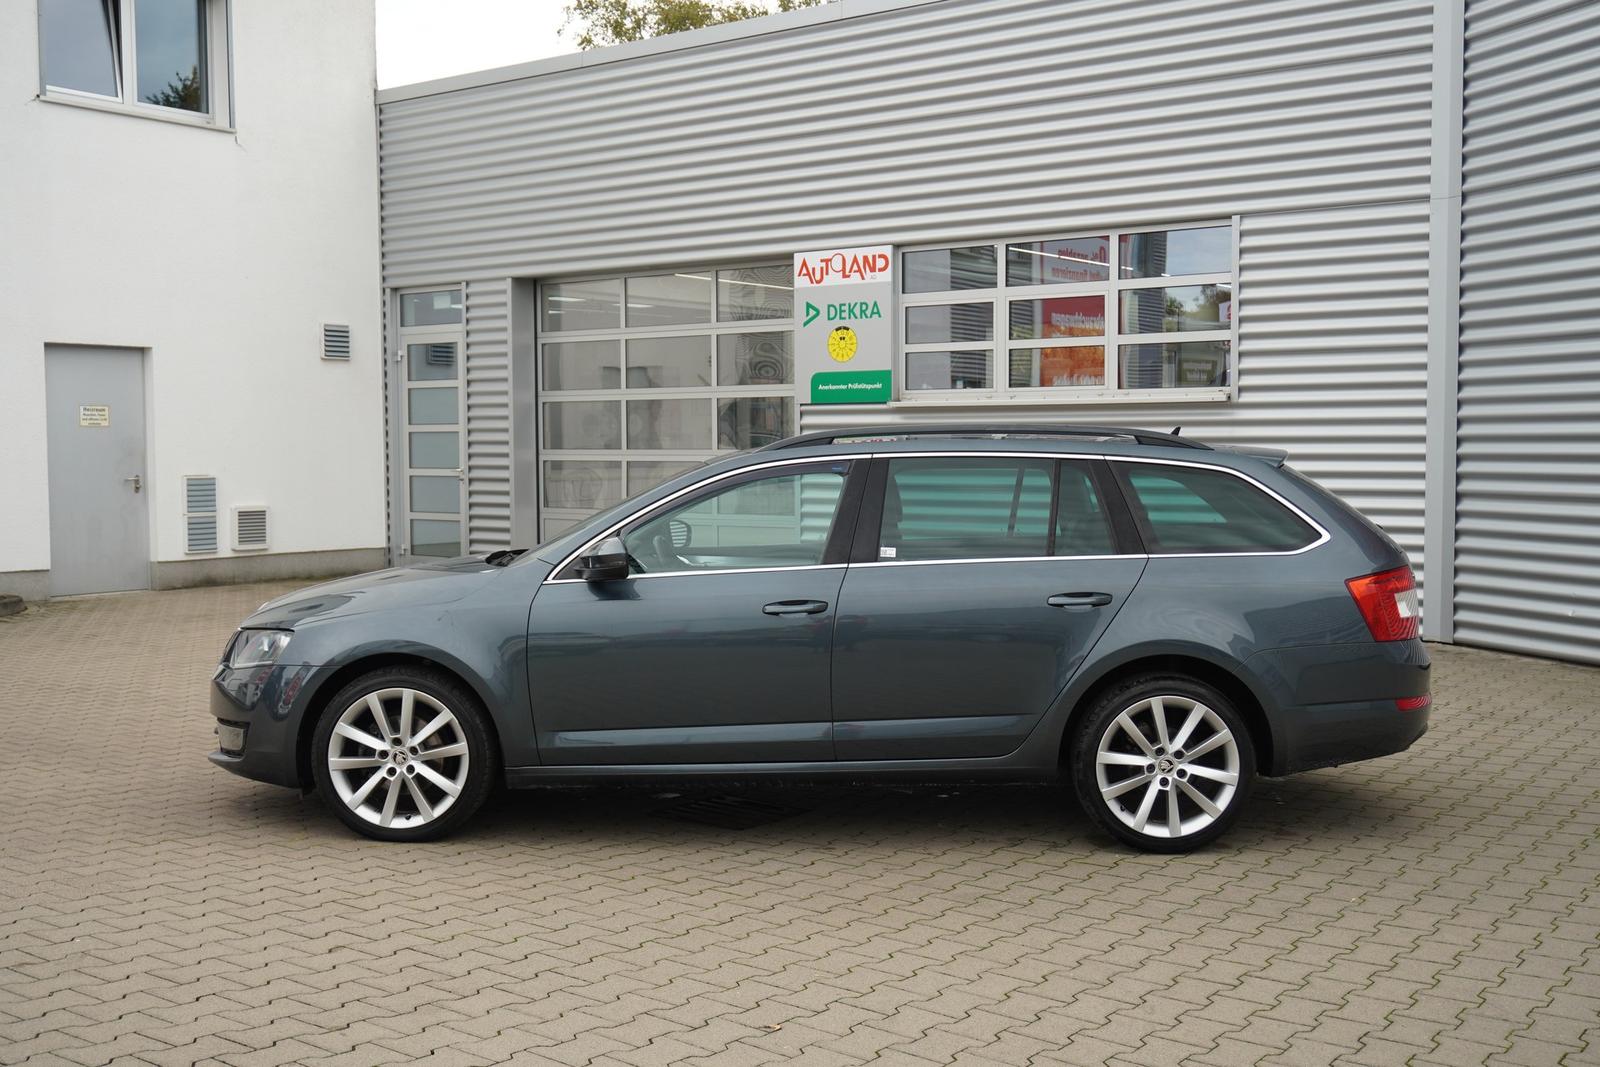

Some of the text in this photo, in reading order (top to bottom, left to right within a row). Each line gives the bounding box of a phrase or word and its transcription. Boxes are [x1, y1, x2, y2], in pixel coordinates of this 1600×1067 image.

[797, 253, 890, 285] AUTOLAND
[826, 300, 882, 322] DEKRA
[818, 381, 882, 392] Anerkannter Prüfstützpunkt
